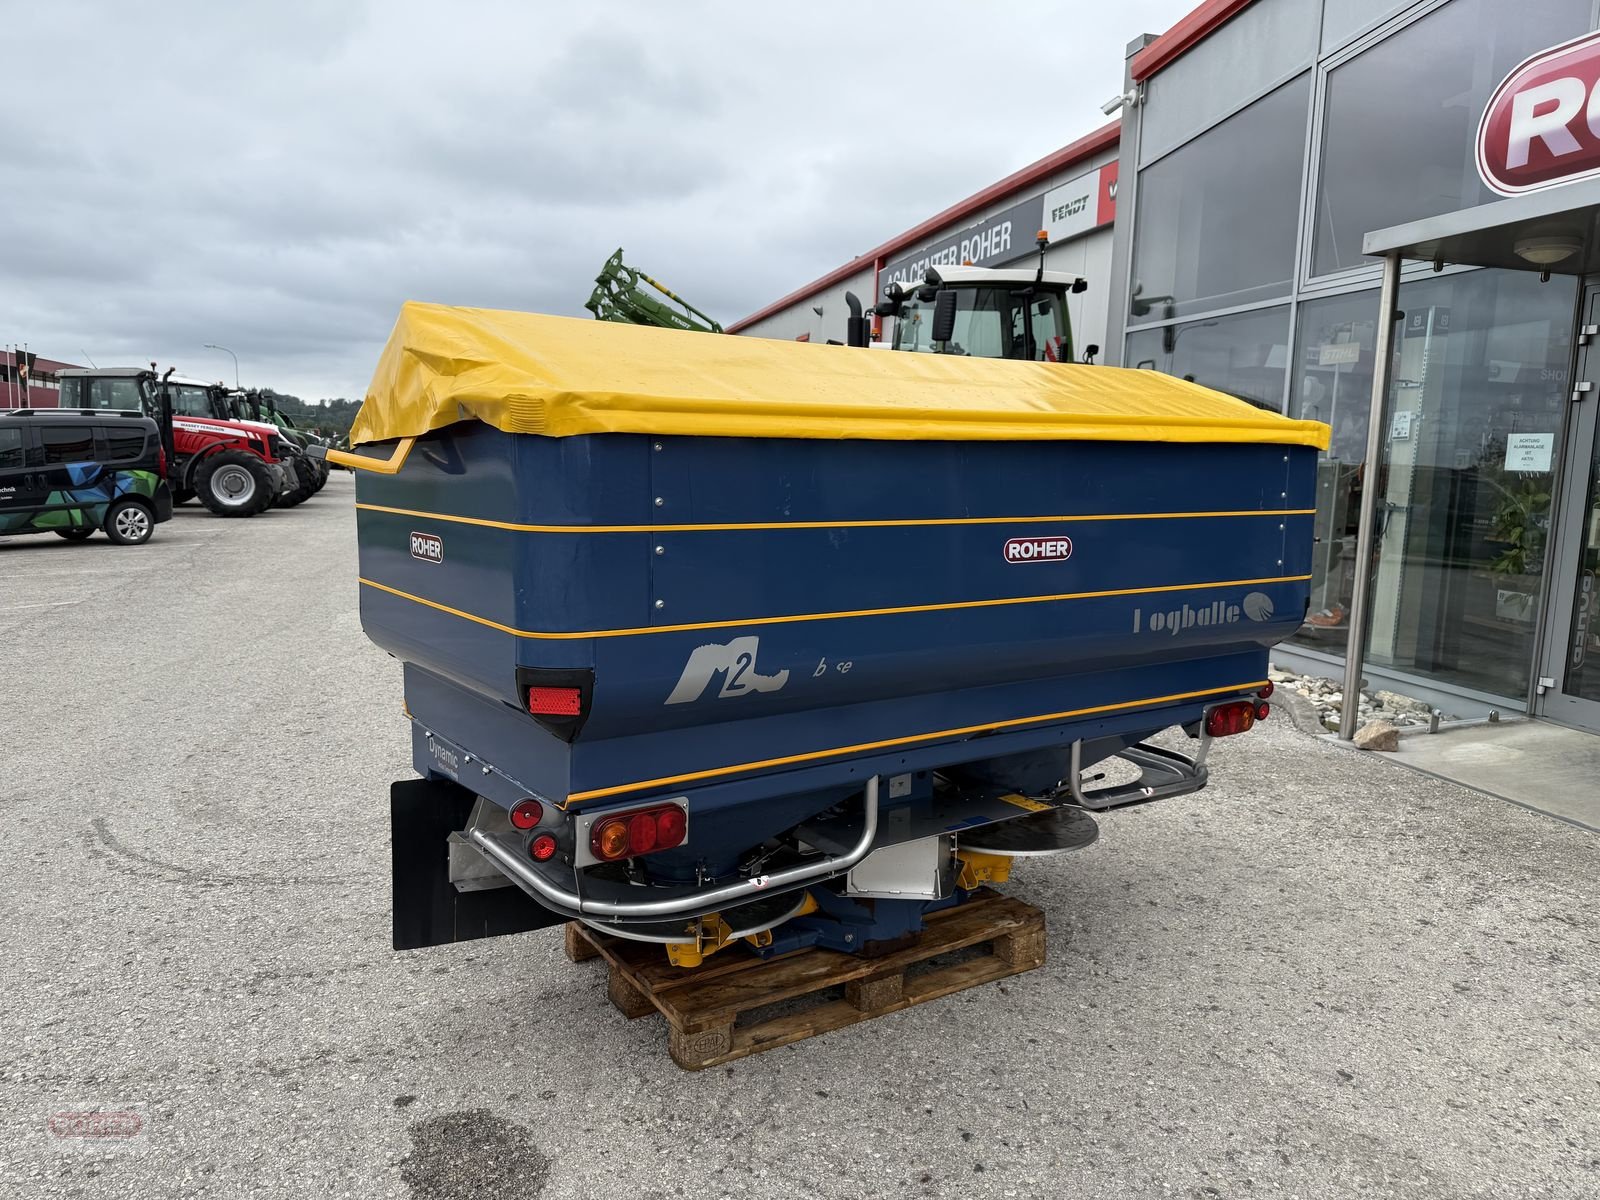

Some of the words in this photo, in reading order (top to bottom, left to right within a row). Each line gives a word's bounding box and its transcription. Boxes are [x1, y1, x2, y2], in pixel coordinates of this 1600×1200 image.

[1505, 76, 1600, 171] R
[1051, 194, 1090, 223] FENDT
[960, 221, 1012, 268] ROHER
[200, 424, 225, 432] FERGUSON
[411, 536, 441, 559] ROHER
[1008, 541, 1068, 559] ROHER
[429, 736, 458, 769] Dynamic
